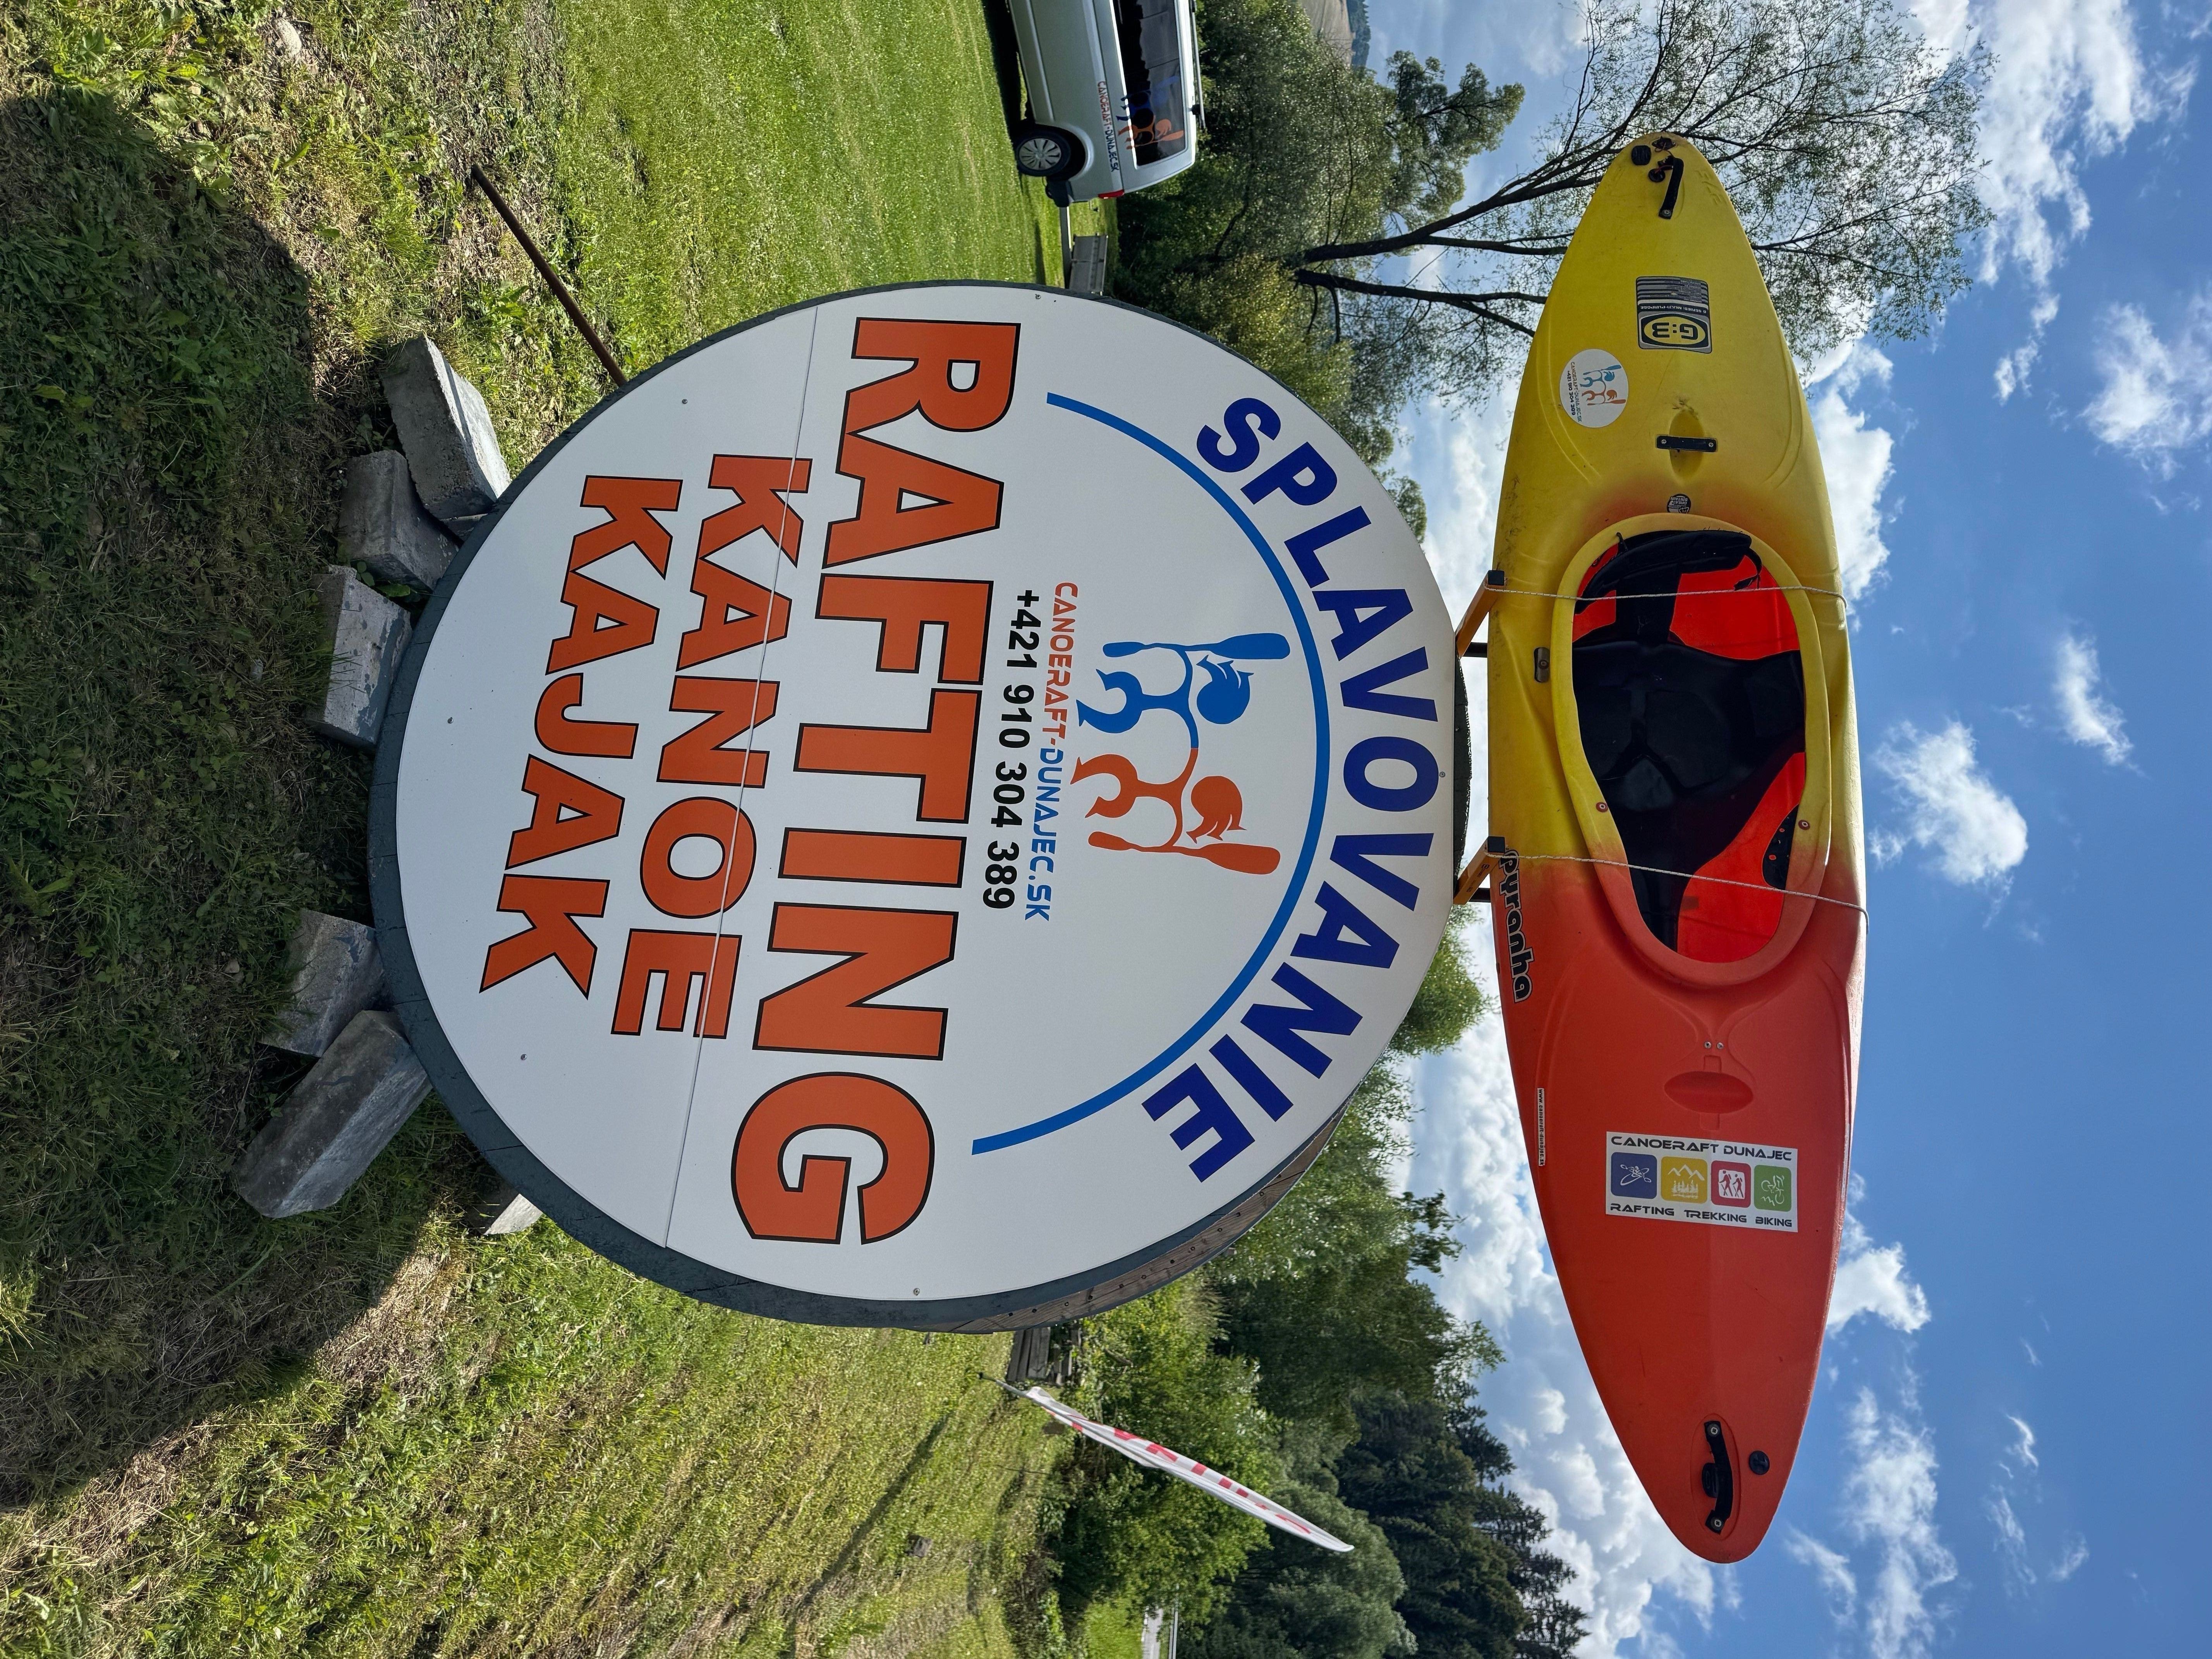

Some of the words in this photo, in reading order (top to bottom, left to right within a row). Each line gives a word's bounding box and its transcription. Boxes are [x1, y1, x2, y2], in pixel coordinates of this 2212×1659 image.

[1652, 322, 1698, 340] G:3
[1007, 590, 1041, 668] +421
[479, 475, 683, 999] KAJAK
[611, 454, 812, 1041] KANOE
[999, 684, 1034, 748] 910
[1025, 582, 1078, 921] CANOERAFT-DUNAJEC.SK
[730, 316, 1021, 1245] RAFTING
[991, 761, 1027, 828] 304
[1142, 397, 1439, 1182] SPLAVOVANIE
[983, 840, 1019, 909] 389
[1498, 849, 1534, 1003] pyranha
[1611, 1136, 1719, 1152] CANOERAFT
[1723, 1145, 1792, 1161] DUNAJEC
[1610, 1203, 1674, 1216] RAFTING
[1684, 1209, 1747, 1223] TREKKING
[1755, 1216, 1792, 1227] BIKING
